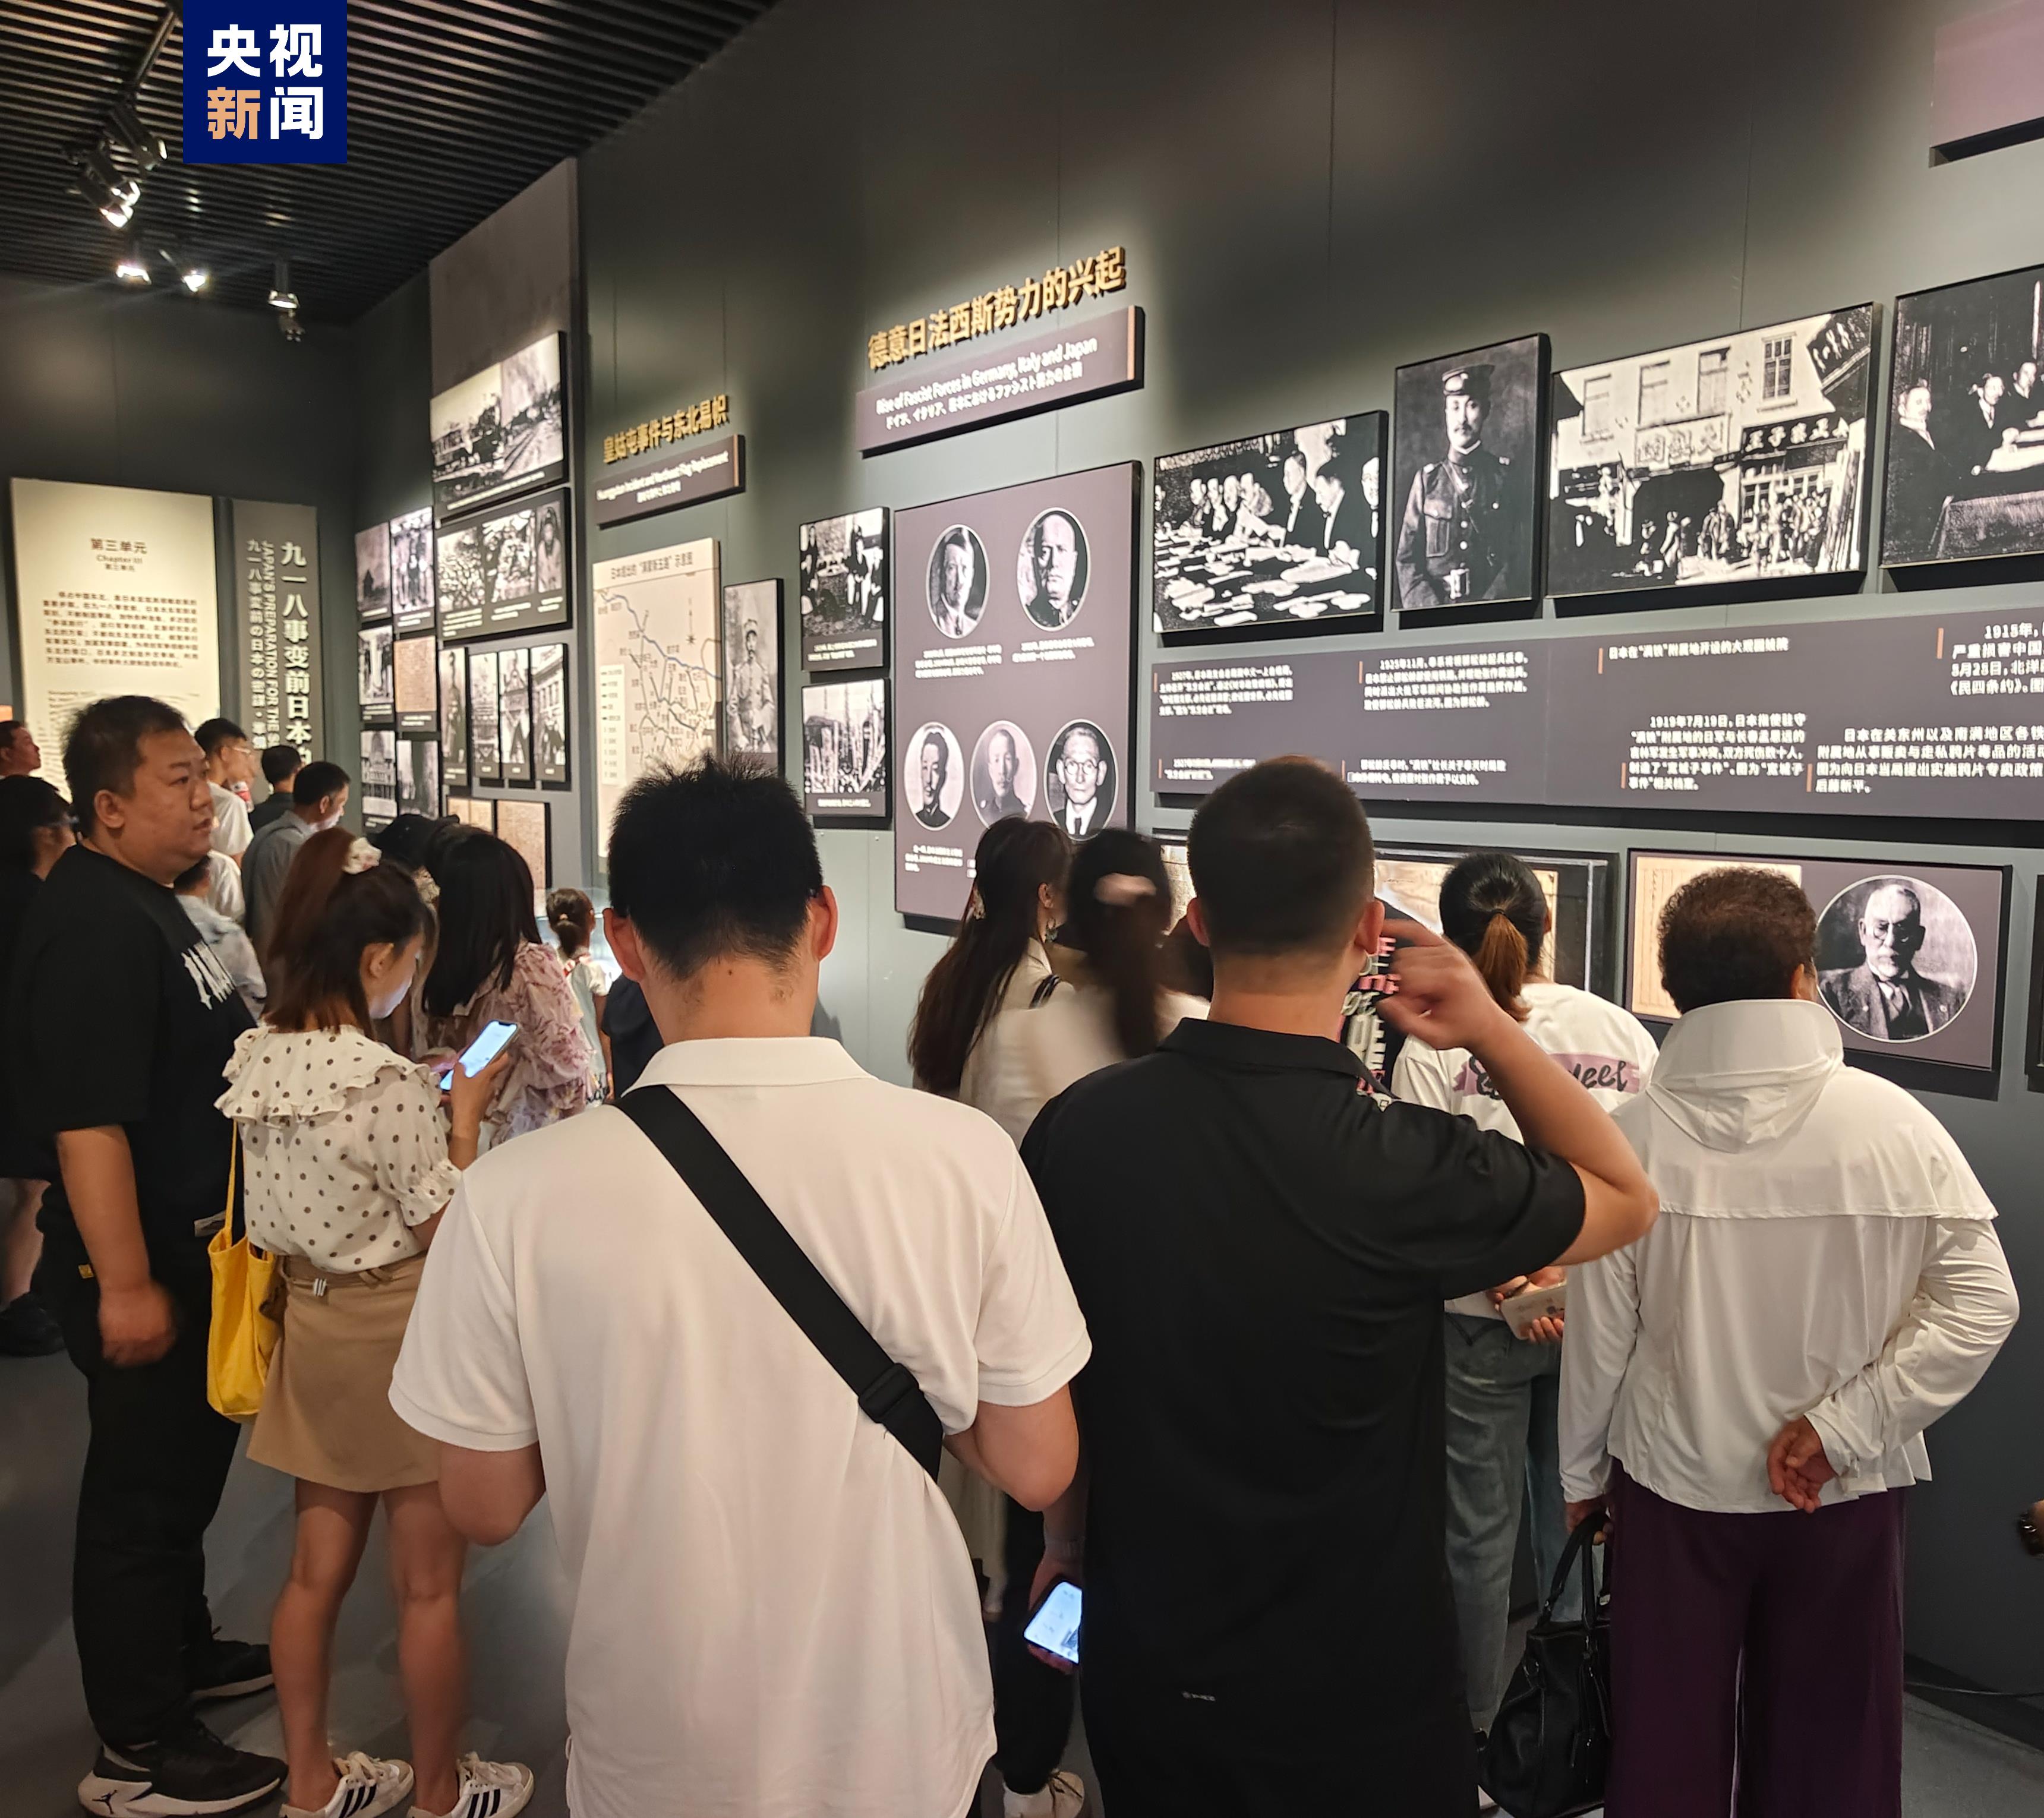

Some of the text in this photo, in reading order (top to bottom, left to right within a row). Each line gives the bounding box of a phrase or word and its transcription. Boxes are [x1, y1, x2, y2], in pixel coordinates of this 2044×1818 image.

[868, 245, 1127, 370] 德意日法西斯势力的兴起
[1063, 337, 1098, 361] Japan
[90, 538, 148, 555] 第三单元
[1984, 621, 2044, 639] 1915年，
[1952, 640, 2044, 659] 严重损害中国
[1951, 658, 2044, 678] 5月25日，北洋
[266, 679, 279, 706] FOR
[267, 706, 280, 734] THE
